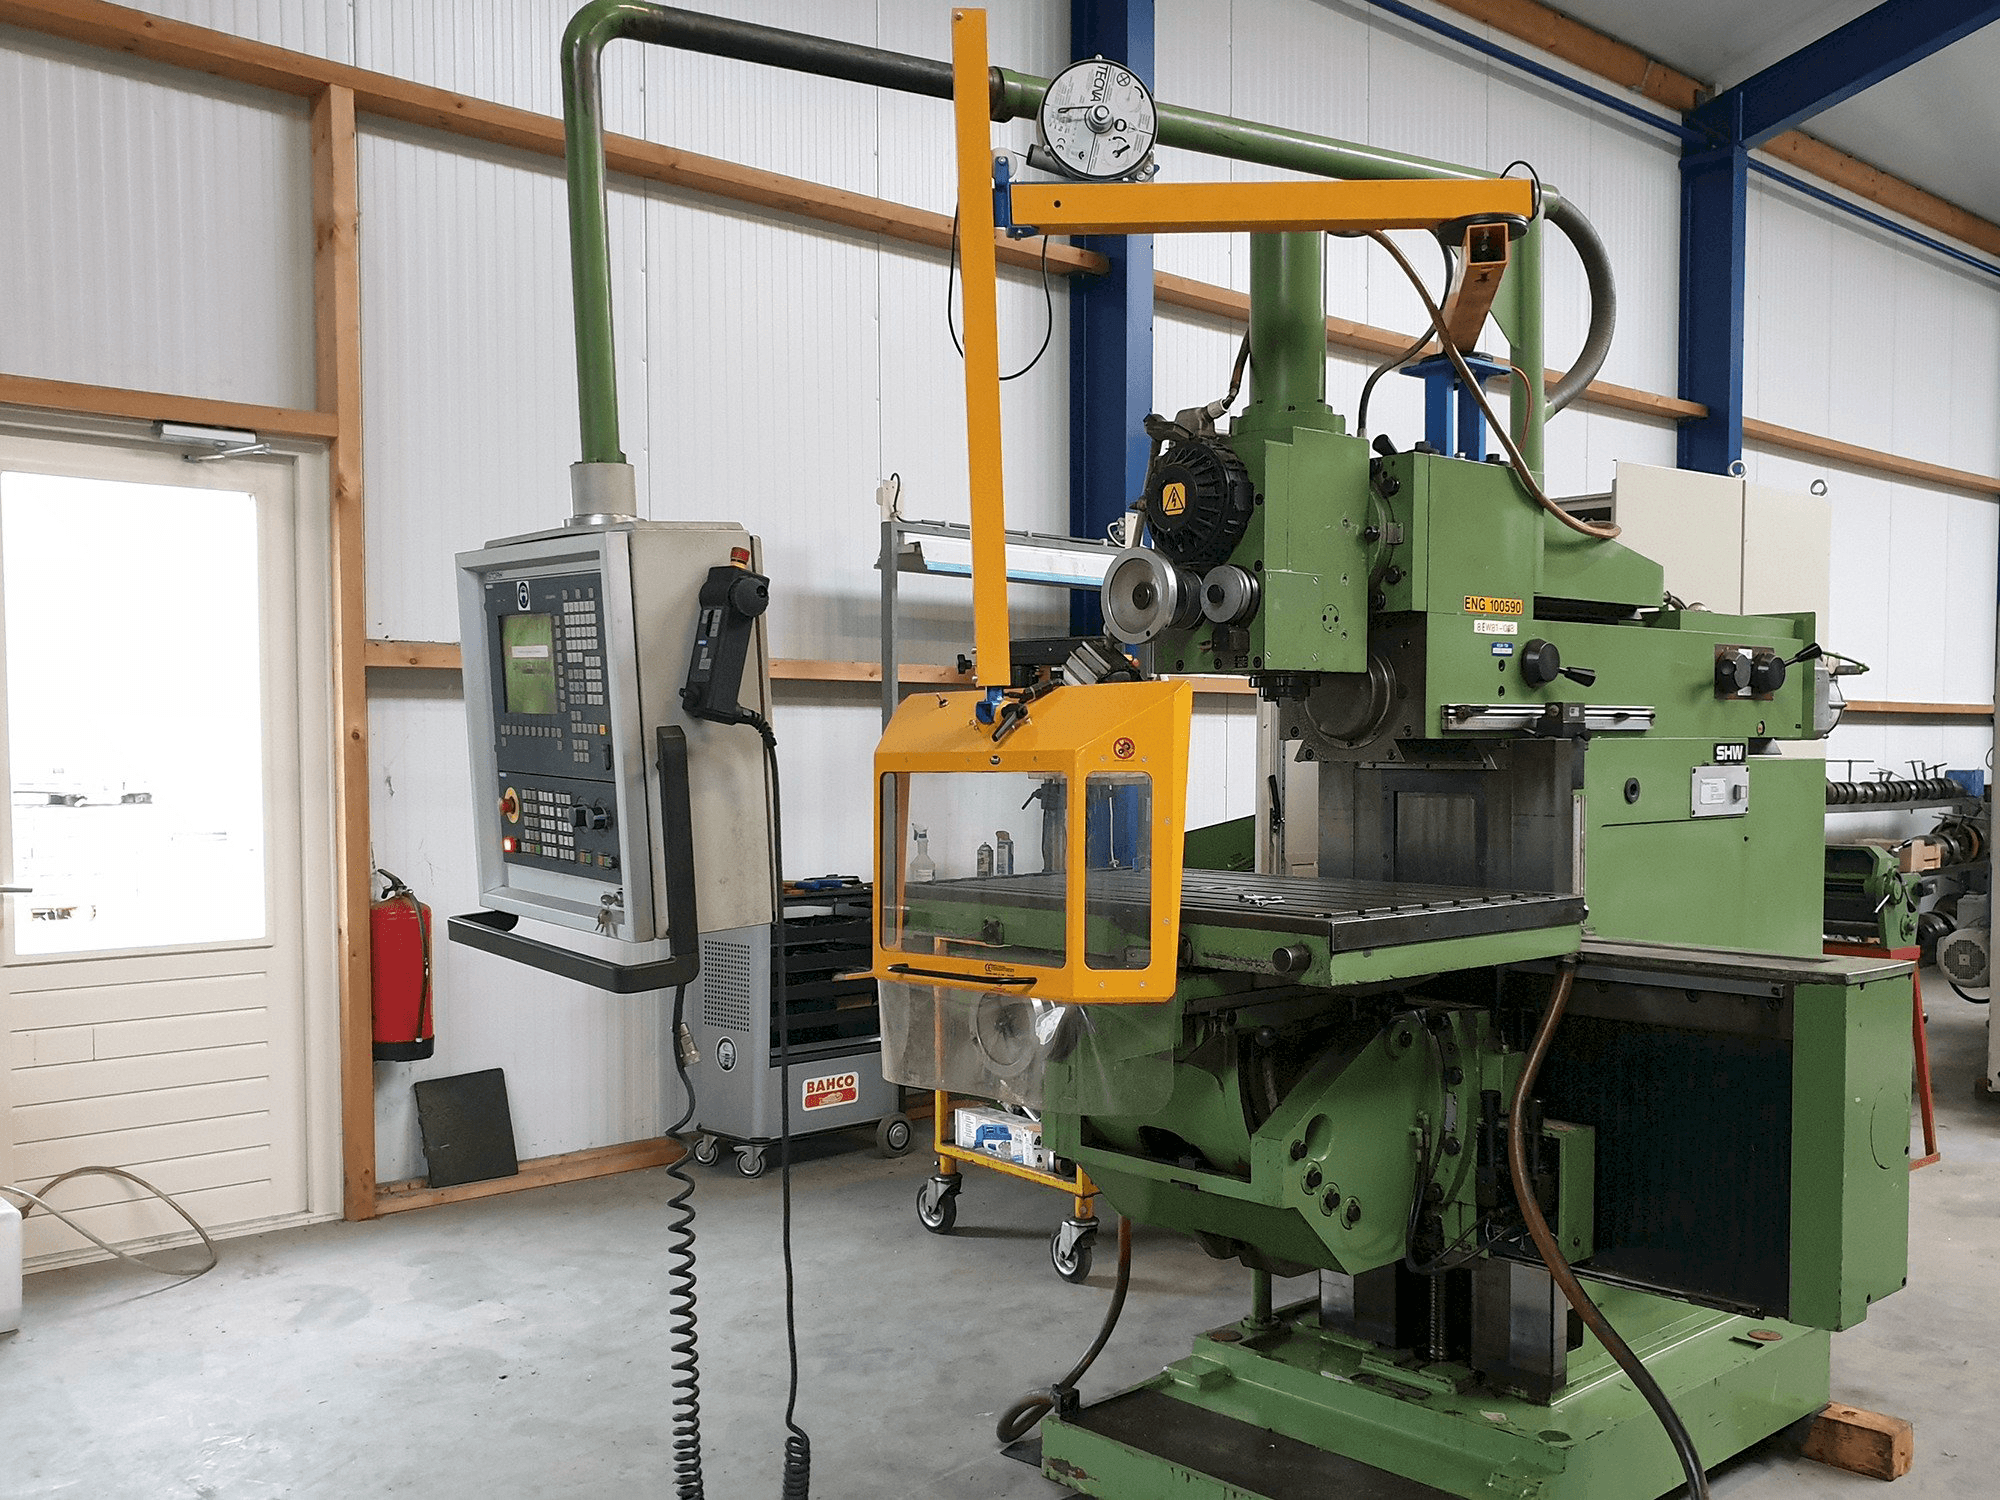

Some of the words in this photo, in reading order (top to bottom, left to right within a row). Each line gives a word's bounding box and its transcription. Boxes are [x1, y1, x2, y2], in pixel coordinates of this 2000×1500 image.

[1090, 65, 1109, 102] TECNA
[1464, 596, 1486, 611] ENG
[1489, 599, 1521, 613] 100590
[1716, 745, 1744, 761] SHW
[807, 1074, 855, 1093] BAHCO
